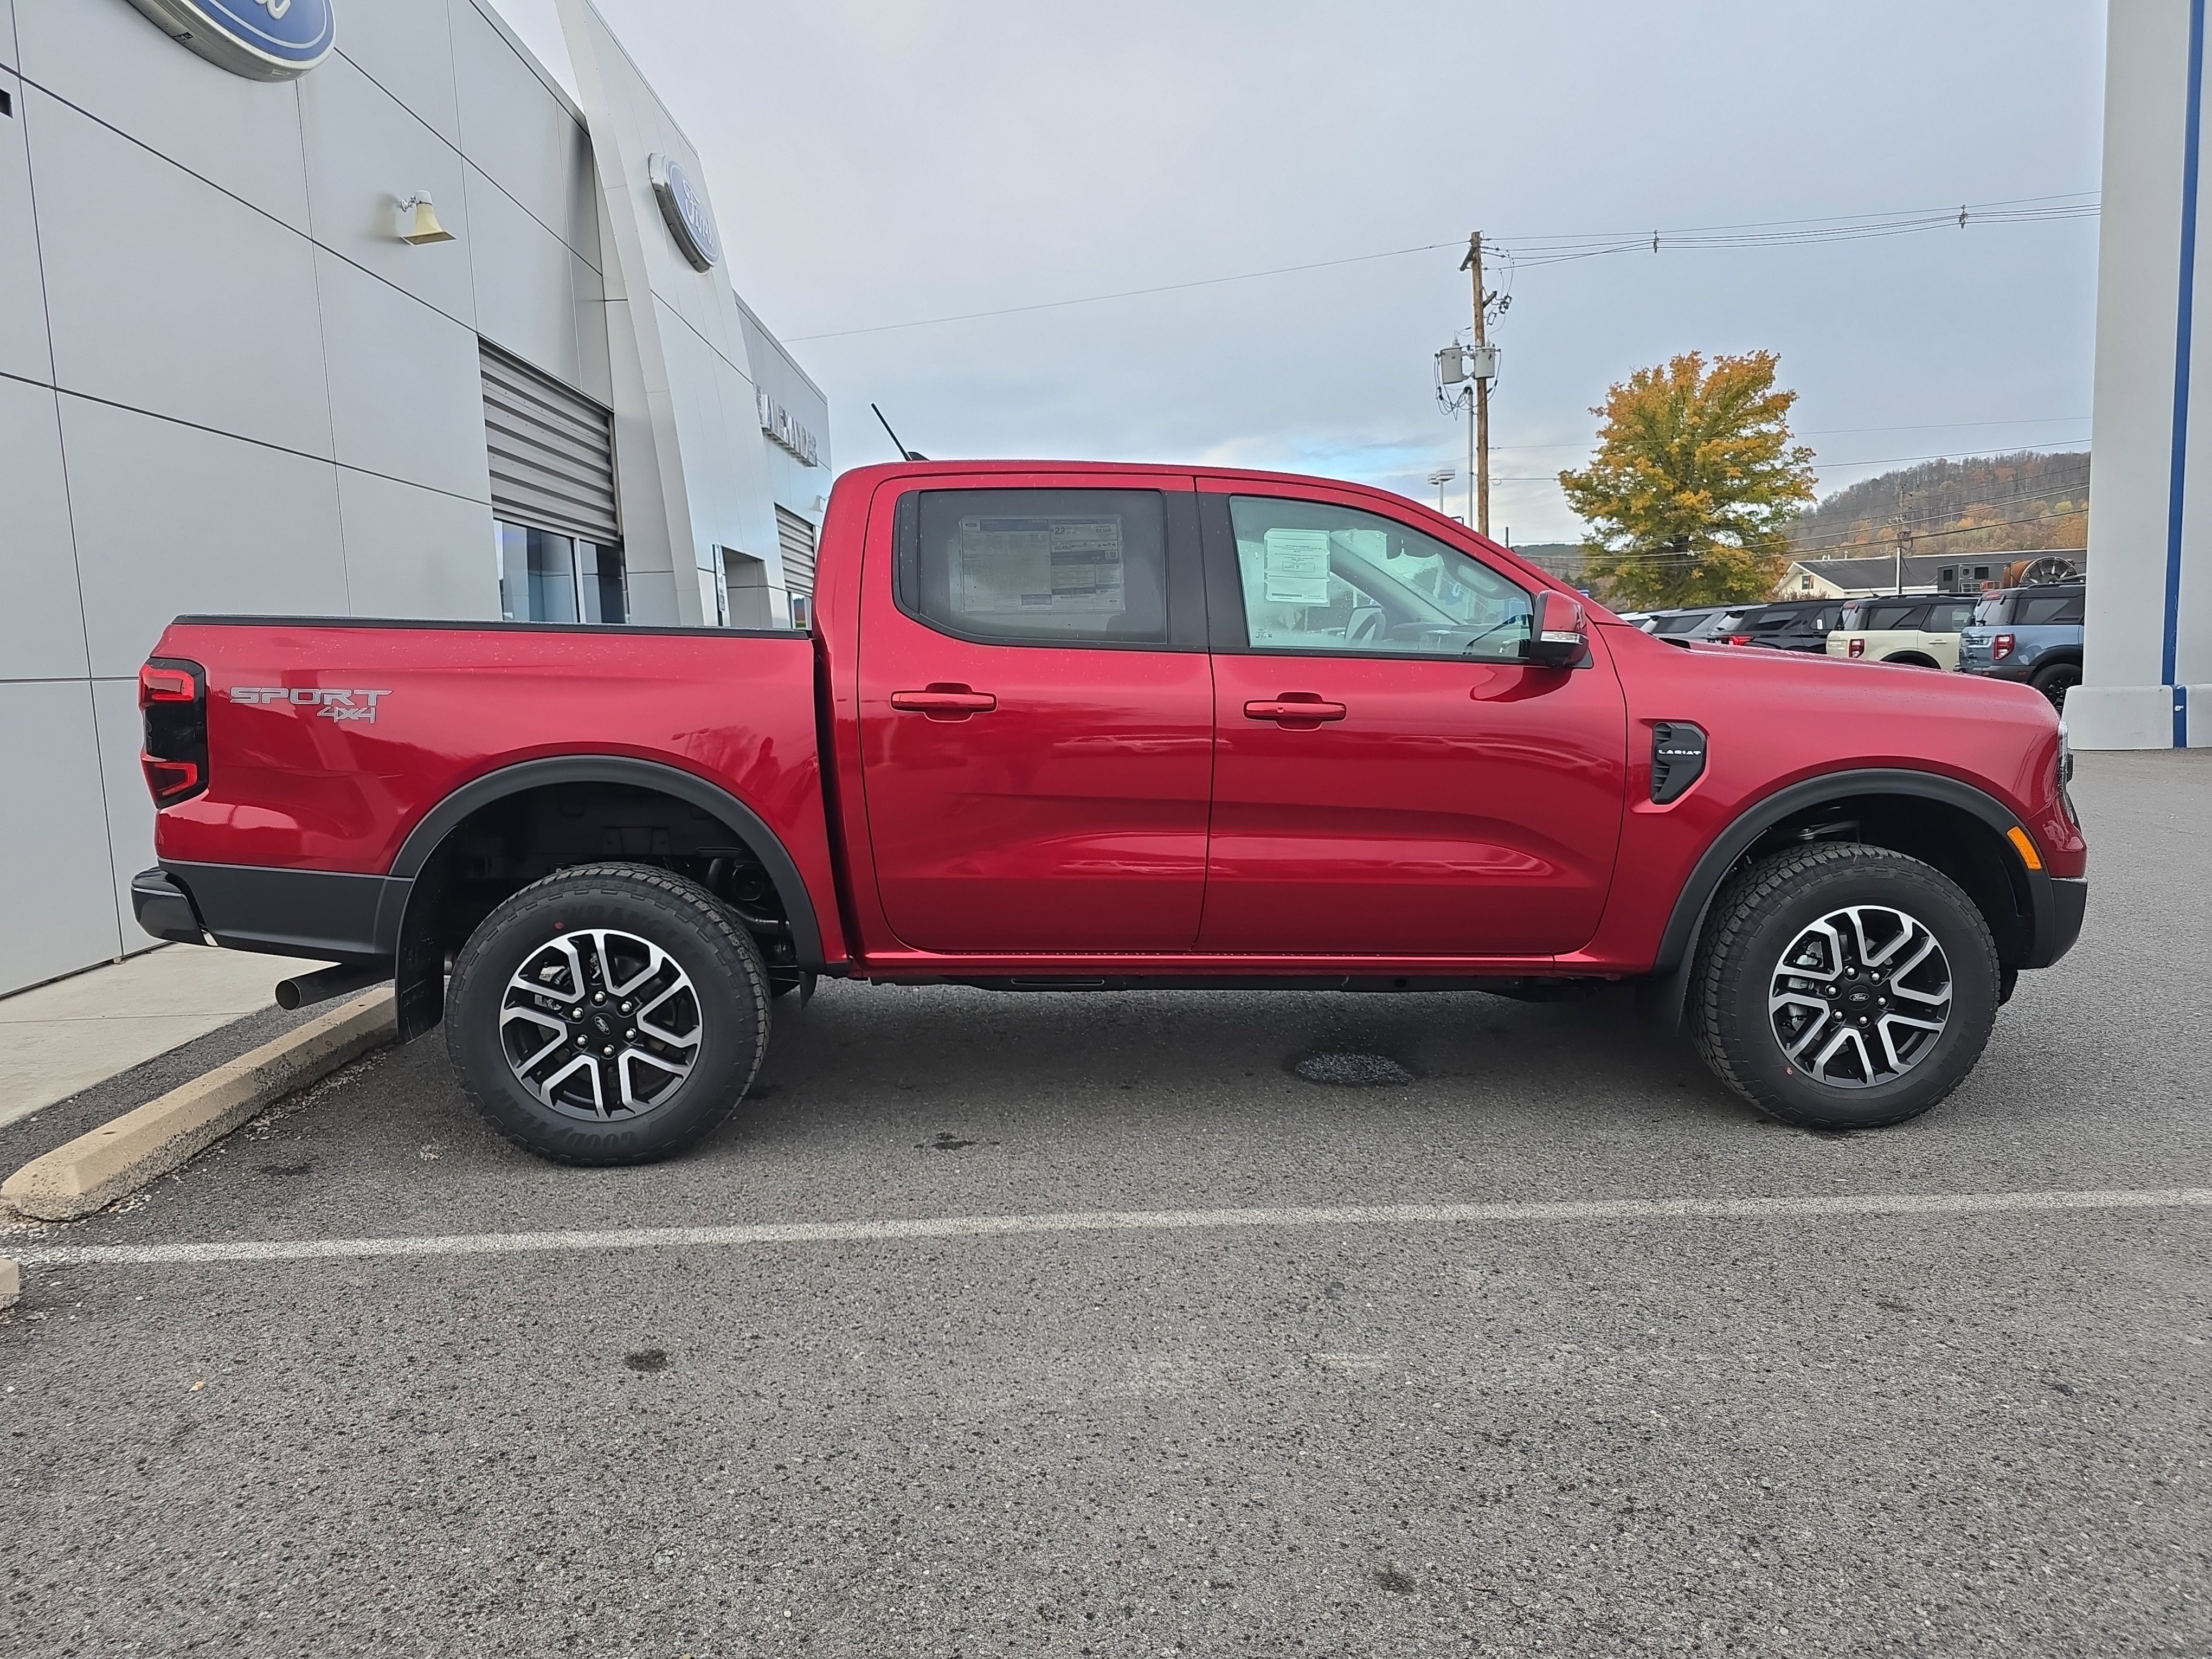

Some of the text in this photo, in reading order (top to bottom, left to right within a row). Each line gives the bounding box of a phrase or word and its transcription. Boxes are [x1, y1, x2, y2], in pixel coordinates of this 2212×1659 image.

[683, 179, 714, 248] Ford
[230, 686, 394, 706] SPORT
[1851, 993, 1868, 1001] Ford
